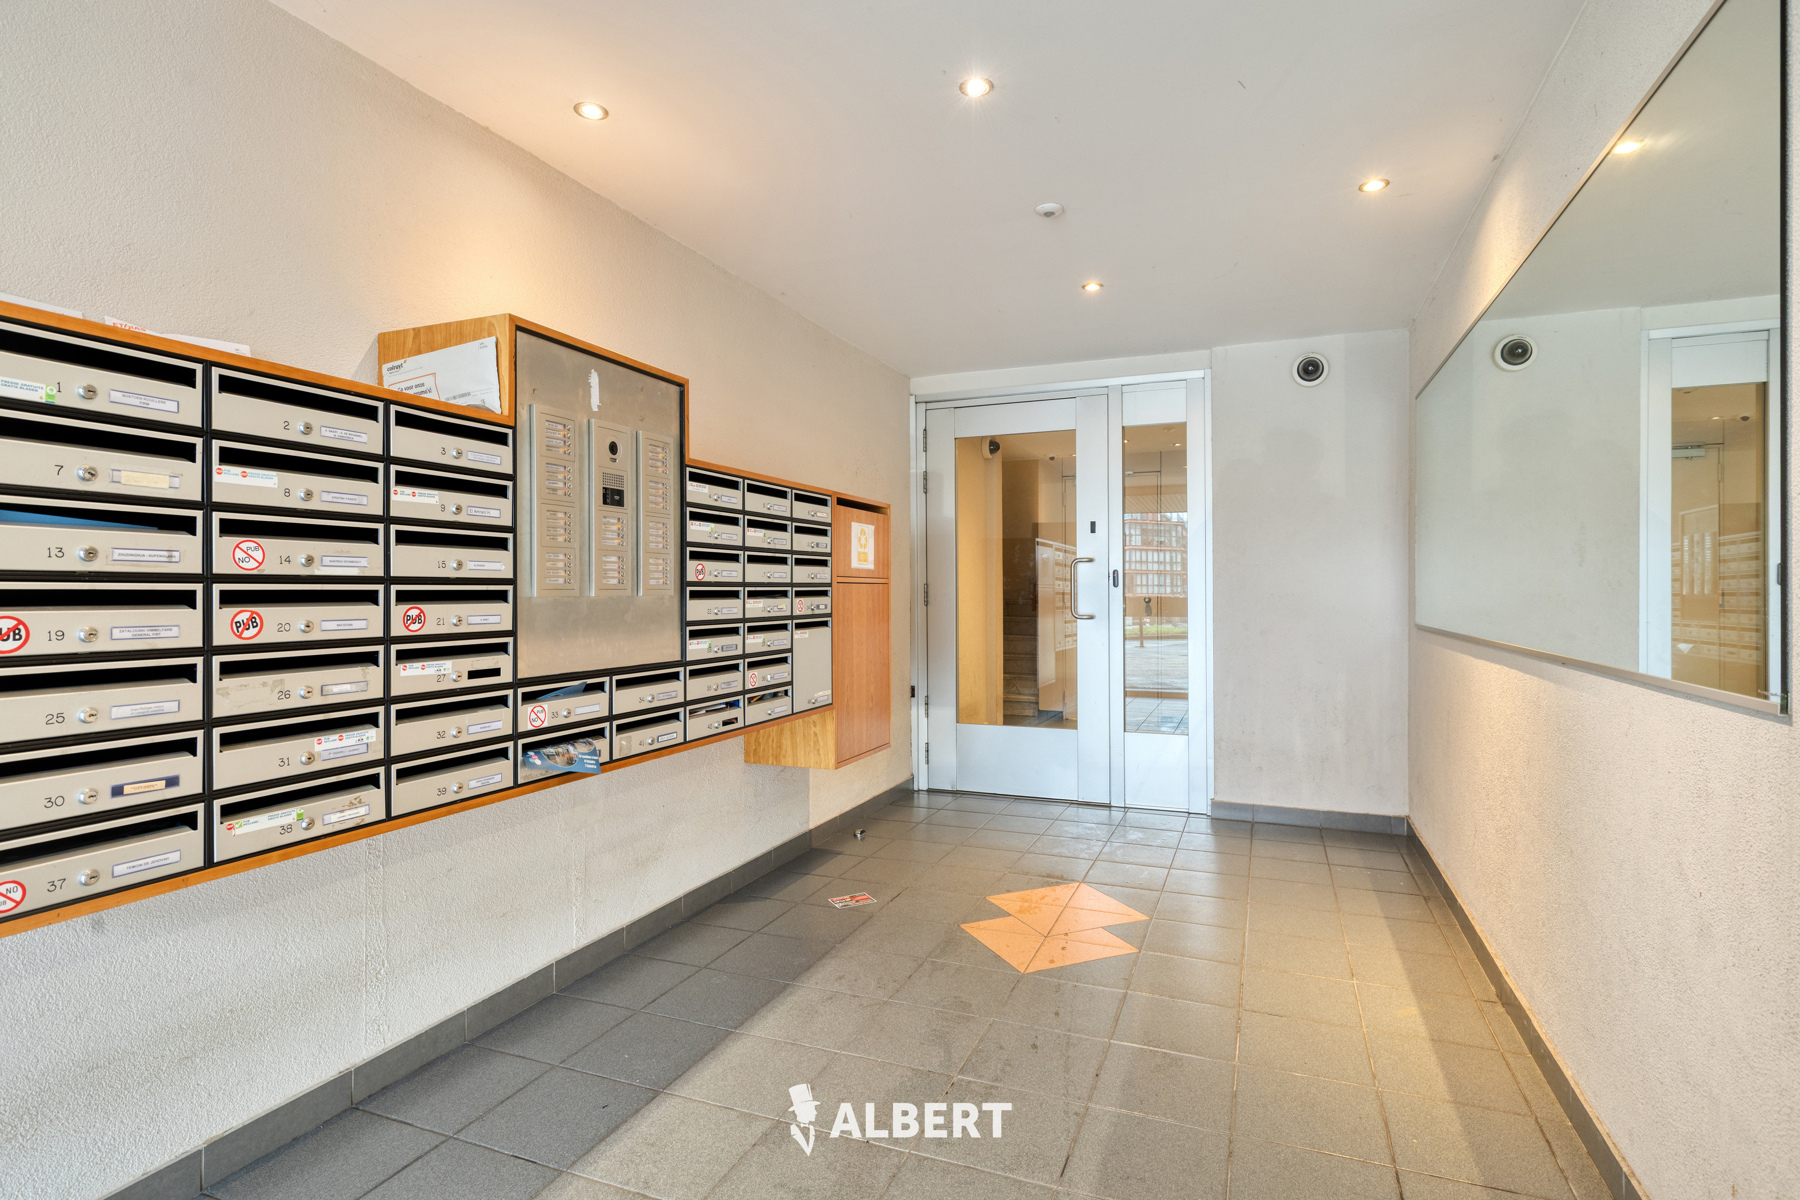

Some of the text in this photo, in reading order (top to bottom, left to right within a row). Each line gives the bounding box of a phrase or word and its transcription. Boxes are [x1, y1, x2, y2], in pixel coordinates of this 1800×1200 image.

[56, 381, 62, 393] 1
[283, 420, 290, 431] 2
[440, 447, 447, 456] 3
[54, 464, 64, 476] 7
[283, 487, 291, 498] 8
[440, 503, 446, 513] 9
[47, 546, 65, 559] 13
[246, 545, 260, 553] PUB
[237, 556, 251, 564] NO
[279, 555, 292, 566] 14
[437, 560, 447, 569] 15
[234, 615, 259, 634] PUB
[405, 614, 423, 625] PUB
[436, 617, 446, 627] 21
[276, 622, 291, 633] 20
[0, 627, 23, 642] UB
[47, 629, 65, 642] 19
[436, 673, 446, 683] 27
[277, 689, 292, 701] 26
[45, 712, 66, 726] 25
[550, 711, 559, 719] 33
[436, 730, 446, 740] 32
[278, 757, 291, 769] 31
[436, 786, 447, 797] 39
[43, 795, 65, 809] 30
[279, 824, 293, 836] 38
[5, 885, 19, 895] NO
[46, 877, 67, 893] 37
